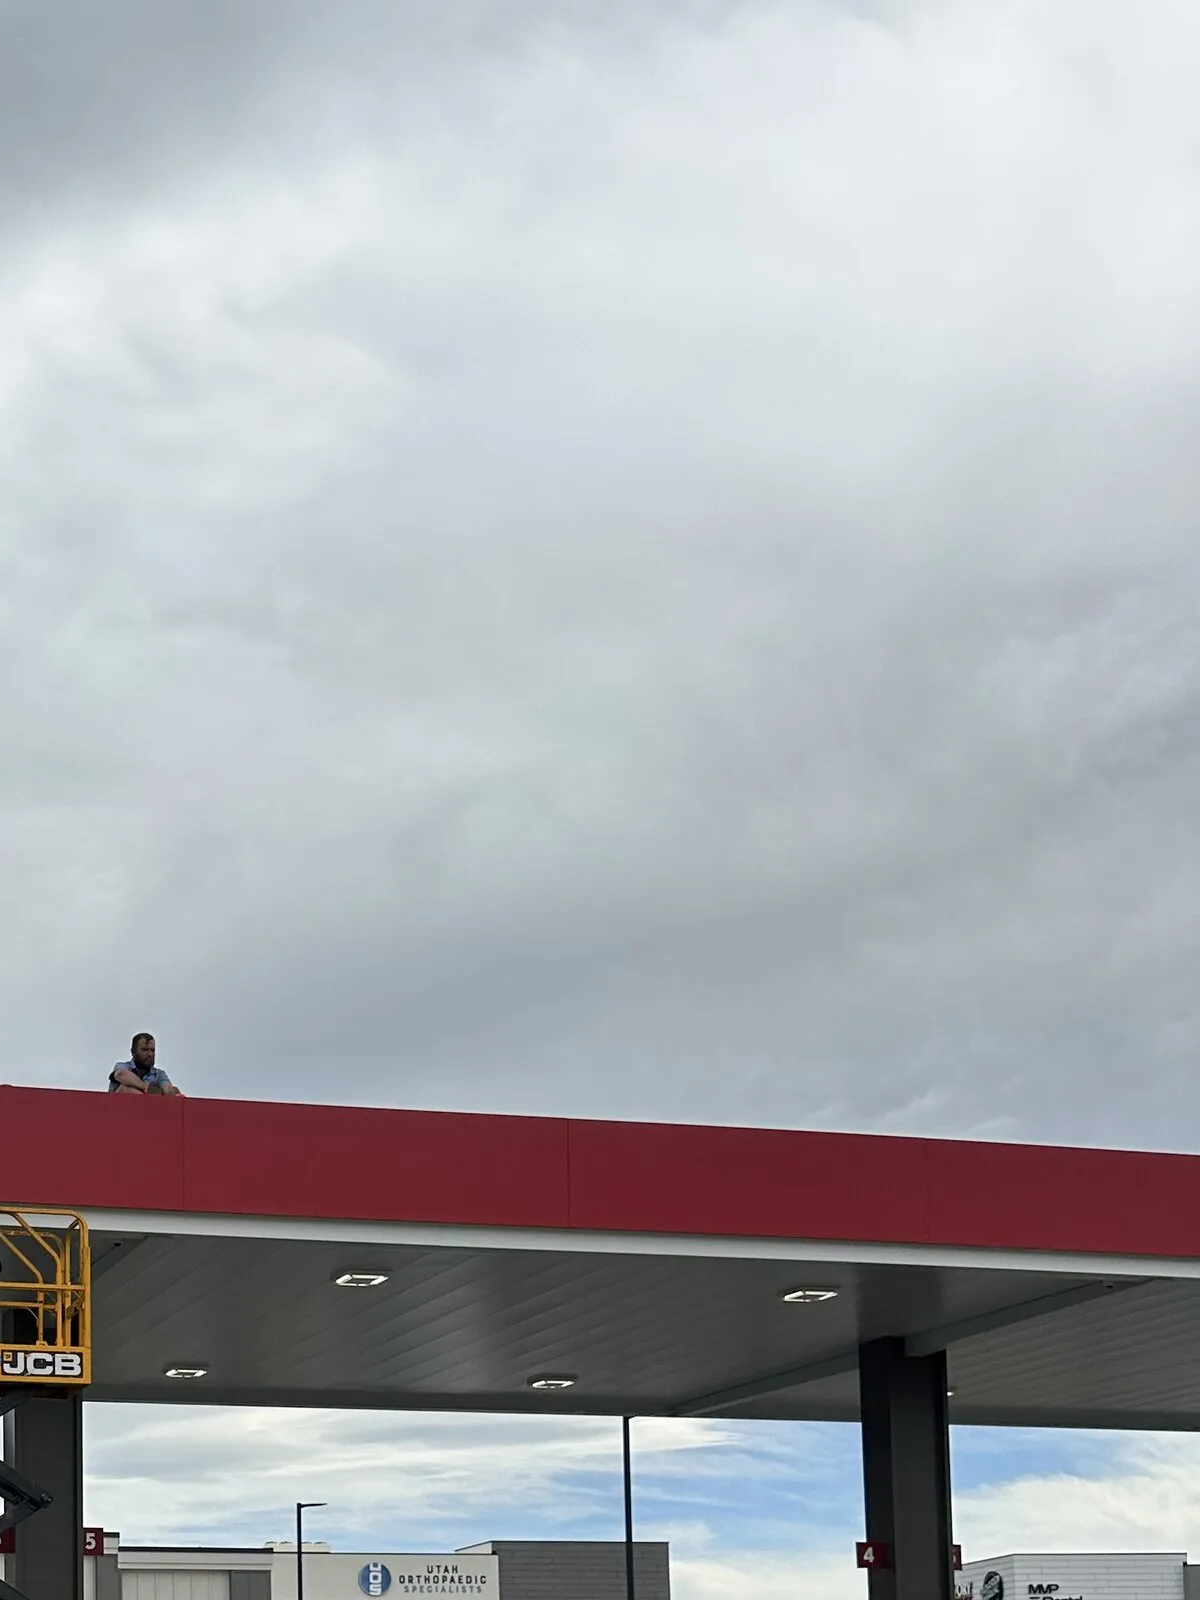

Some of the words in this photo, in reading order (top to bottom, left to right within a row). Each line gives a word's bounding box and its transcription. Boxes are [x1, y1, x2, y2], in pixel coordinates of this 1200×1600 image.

[3, 1353, 82, 1376] JCB
[84, 1532, 97, 1550] 5
[863, 1547, 875, 1563] 4
[426, 1564, 459, 1574] UTAH
[399, 1575, 487, 1584] ORTHOPAEDIC
[403, 1585, 483, 1593] SPECIALISTS
[1028, 1584, 1060, 1594] MVP
